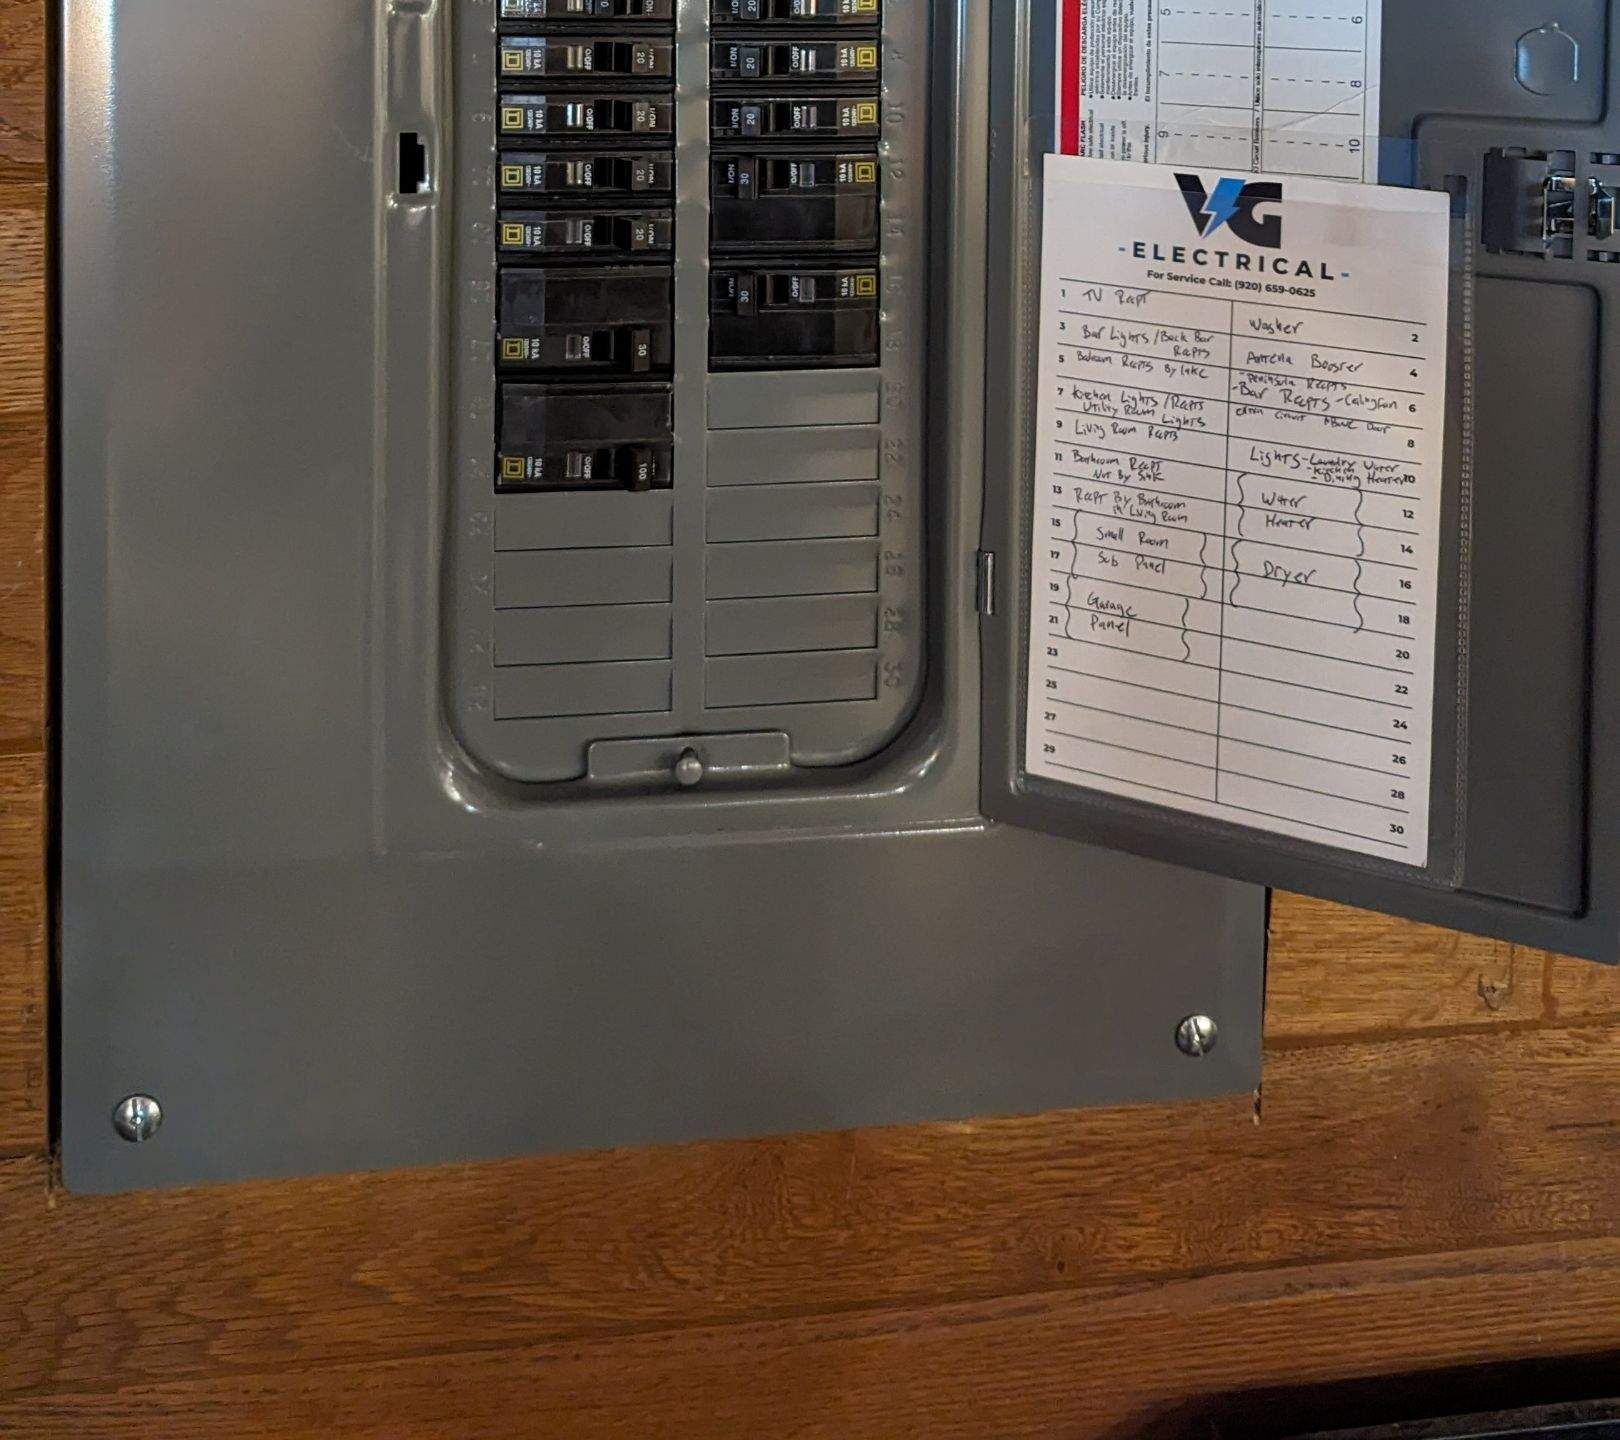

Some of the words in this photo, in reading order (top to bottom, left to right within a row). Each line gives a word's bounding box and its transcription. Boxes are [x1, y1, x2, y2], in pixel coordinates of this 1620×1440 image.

[748, 0, 756, 11] 20
[1352, 16, 1362, 24] 6
[637, 52, 645, 63] 20
[746, 57, 755, 69] 20
[1351, 80, 1361, 88] 8
[637, 111, 645, 122] 20
[746, 113, 755, 125] 20
[1349, 139, 1360, 154] 10
[637, 170, 644, 181] 20
[740, 173, 749, 184] 30
[636, 229, 643, 240] 20
[1146, 270, 1164, 280] For
[1166, 272, 1206, 286] Service
[1234, 280, 1261, 294] (920)
[1265, 284, 1316, 298] 659-0625
[740, 291, 749, 302] 30
[1061, 289, 1065, 297] 1
[1059, 322, 1065, 330] 3
[1249, 319, 1304, 334] Washer
[1411, 334, 1419, 342] 2
[638, 344, 646, 356] 30
[1059, 355, 1064, 363] 5
[1410, 369, 1417, 377] 4
[1057, 387, 1063, 395] 7
[1409, 404, 1416, 413] 6
[1056, 420, 1062, 428] 9
[1407, 440, 1415, 448] 8
[1055, 452, 1062, 461] 11
[639, 463, 647, 480] 100
[1403, 474, 1415, 484] 10
[1053, 485, 1062, 494] 13
[1402, 509, 1414, 519] 12
[1051, 518, 1061, 527] 15
[1401, 544, 1413, 554] 14
[1050, 551, 1060, 559] 17
[1264, 560, 1317, 587] Dryer
[1049, 583, 1059, 591] 19
[1400, 579, 1412, 589] 16
[1049, 615, 1058, 624] 21
[1398, 614, 1410, 625] 18
[1047, 647, 1058, 657] 23
[1396, 649, 1410, 660] 20
[1045, 680, 1057, 689] 25
[1394, 684, 1409, 695] 22
[1044, 712, 1056, 722] 27
[1393, 719, 1408, 730] 24
[1043, 744, 1056, 754] 29
[1392, 755, 1407, 765] 26
[1390, 790, 1406, 800] 28
[1389, 824, 1404, 836] 30
